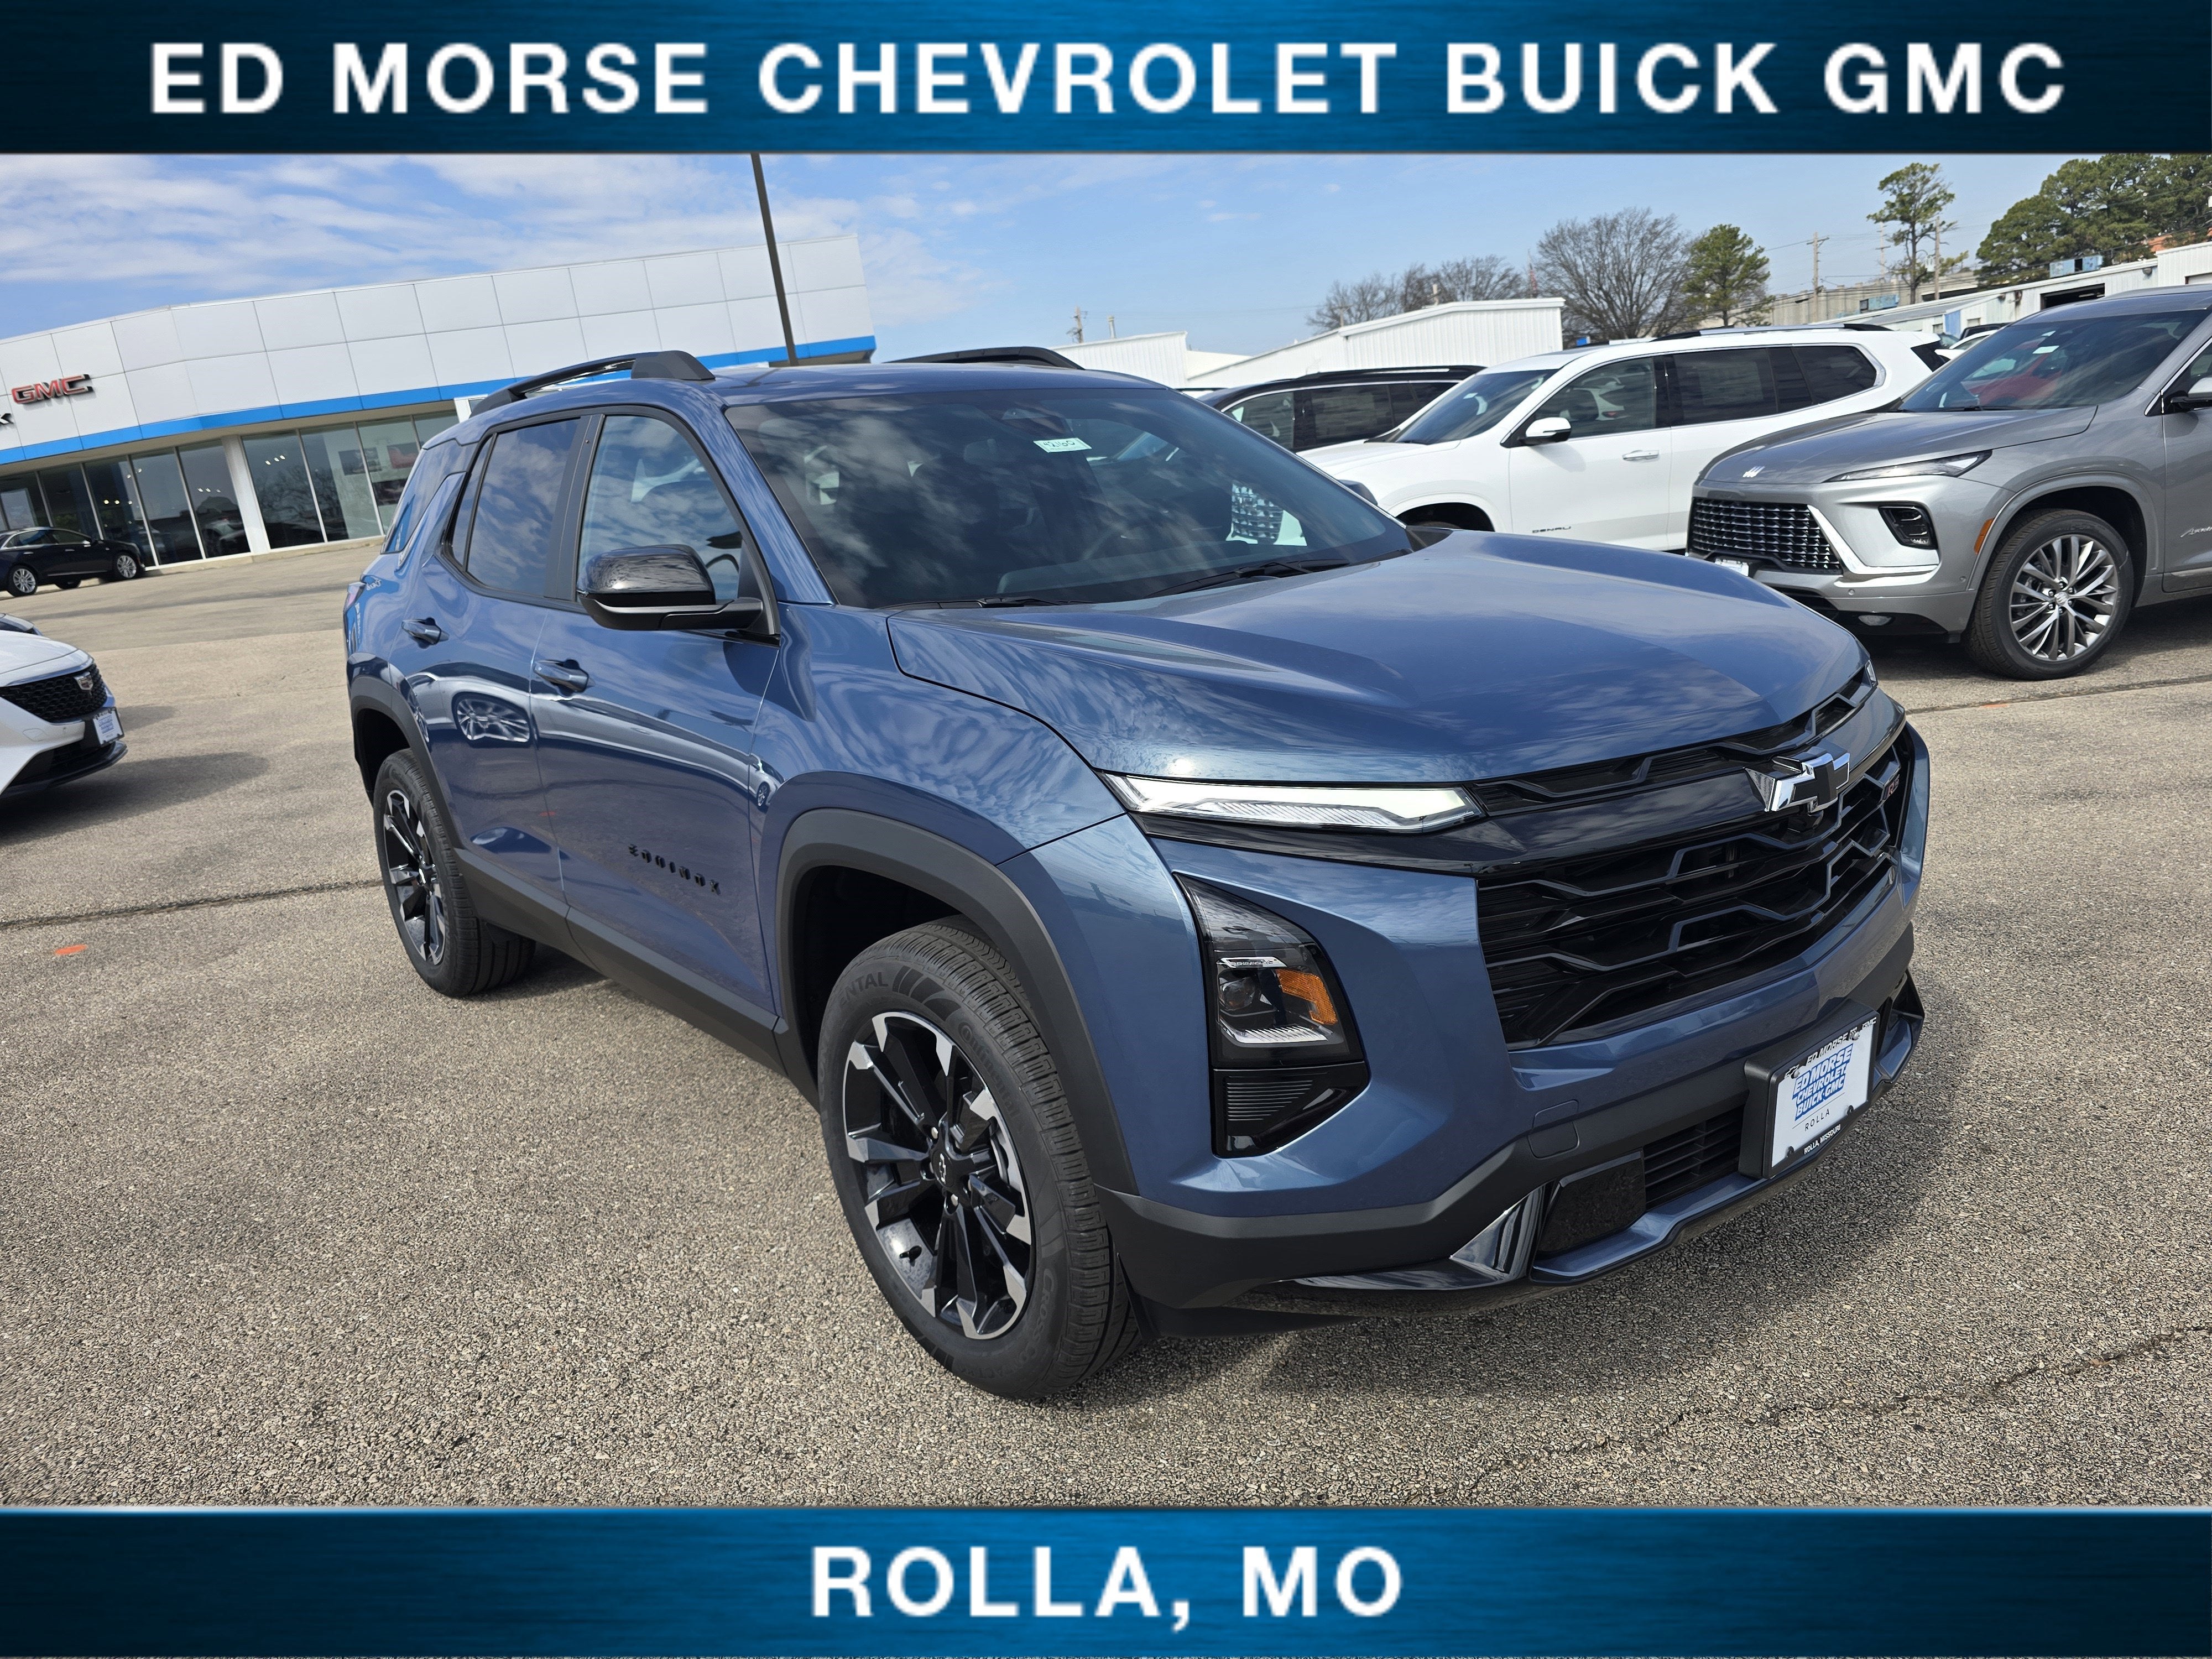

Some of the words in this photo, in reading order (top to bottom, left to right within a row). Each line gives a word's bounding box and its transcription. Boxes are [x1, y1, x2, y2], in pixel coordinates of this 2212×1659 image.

[11, 374, 92, 404] GMC
[1819, 1032, 1848, 1056] MORSE
[1792, 1070, 1811, 1098] ED
[1810, 1043, 1853, 1081] MORSE
[1797, 1063, 1847, 1105] CHEVROLET
[1805, 1108, 1830, 1131] ROLLA
[1804, 1139, 1820, 1155] ROLLA,
[1820, 1124, 1841, 1144] MISSOURI
